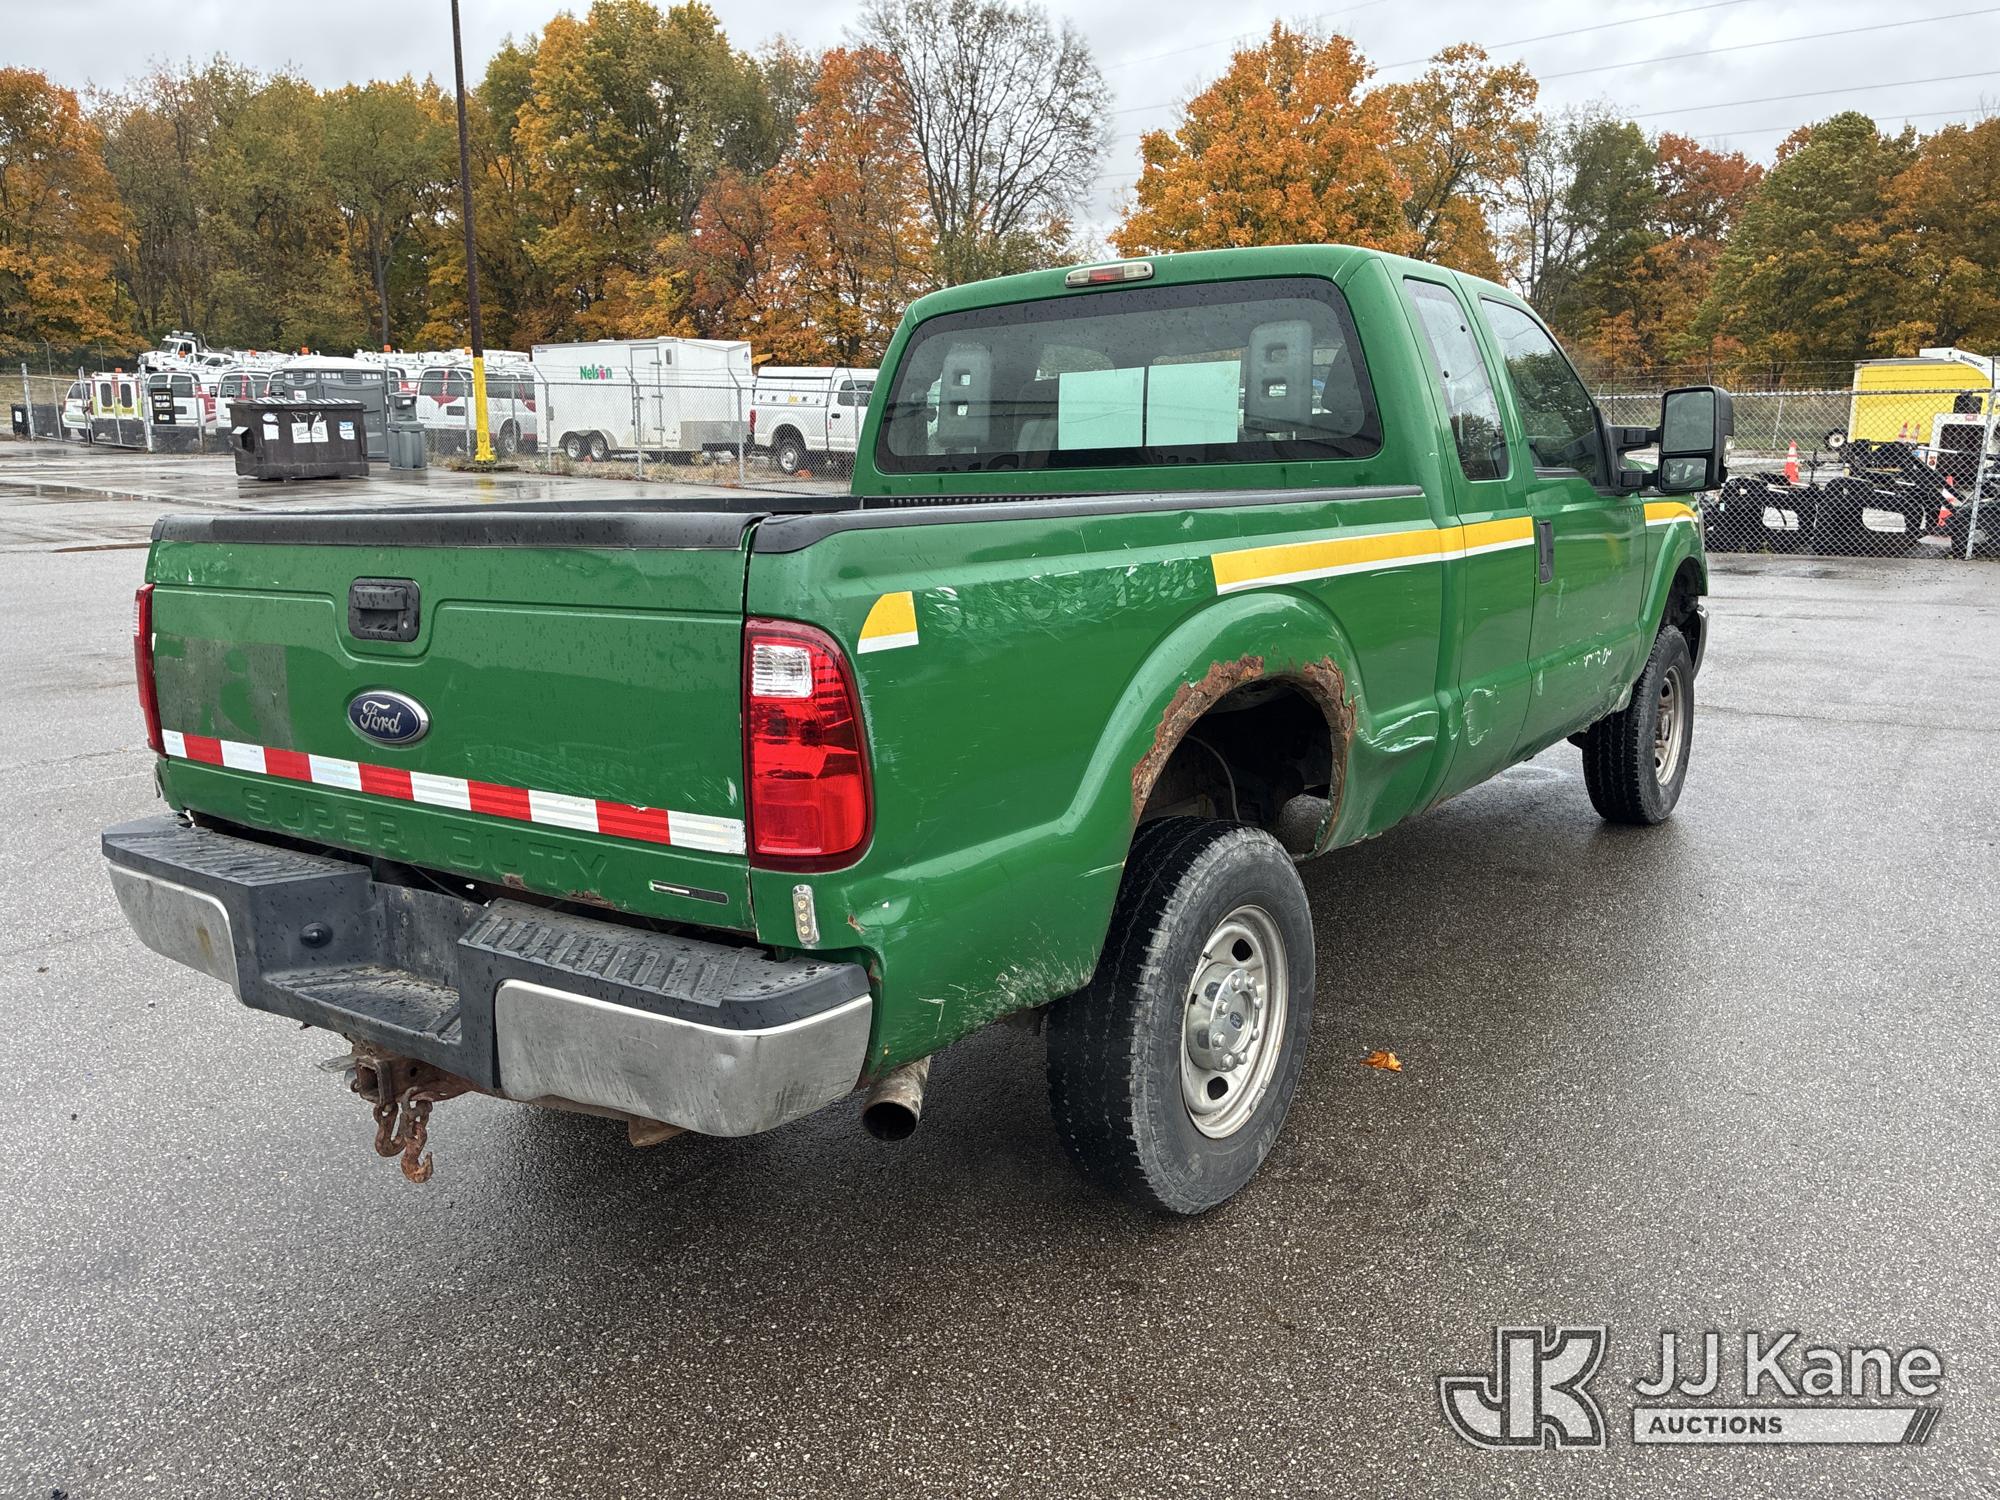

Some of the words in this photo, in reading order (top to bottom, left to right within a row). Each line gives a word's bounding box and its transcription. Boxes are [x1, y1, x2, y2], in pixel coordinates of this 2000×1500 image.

[580, 364, 613, 380] Nelson
[360, 700, 402, 734] Ford
[242, 787, 409, 855] SUPER
[443, 825, 608, 889] DUTY
